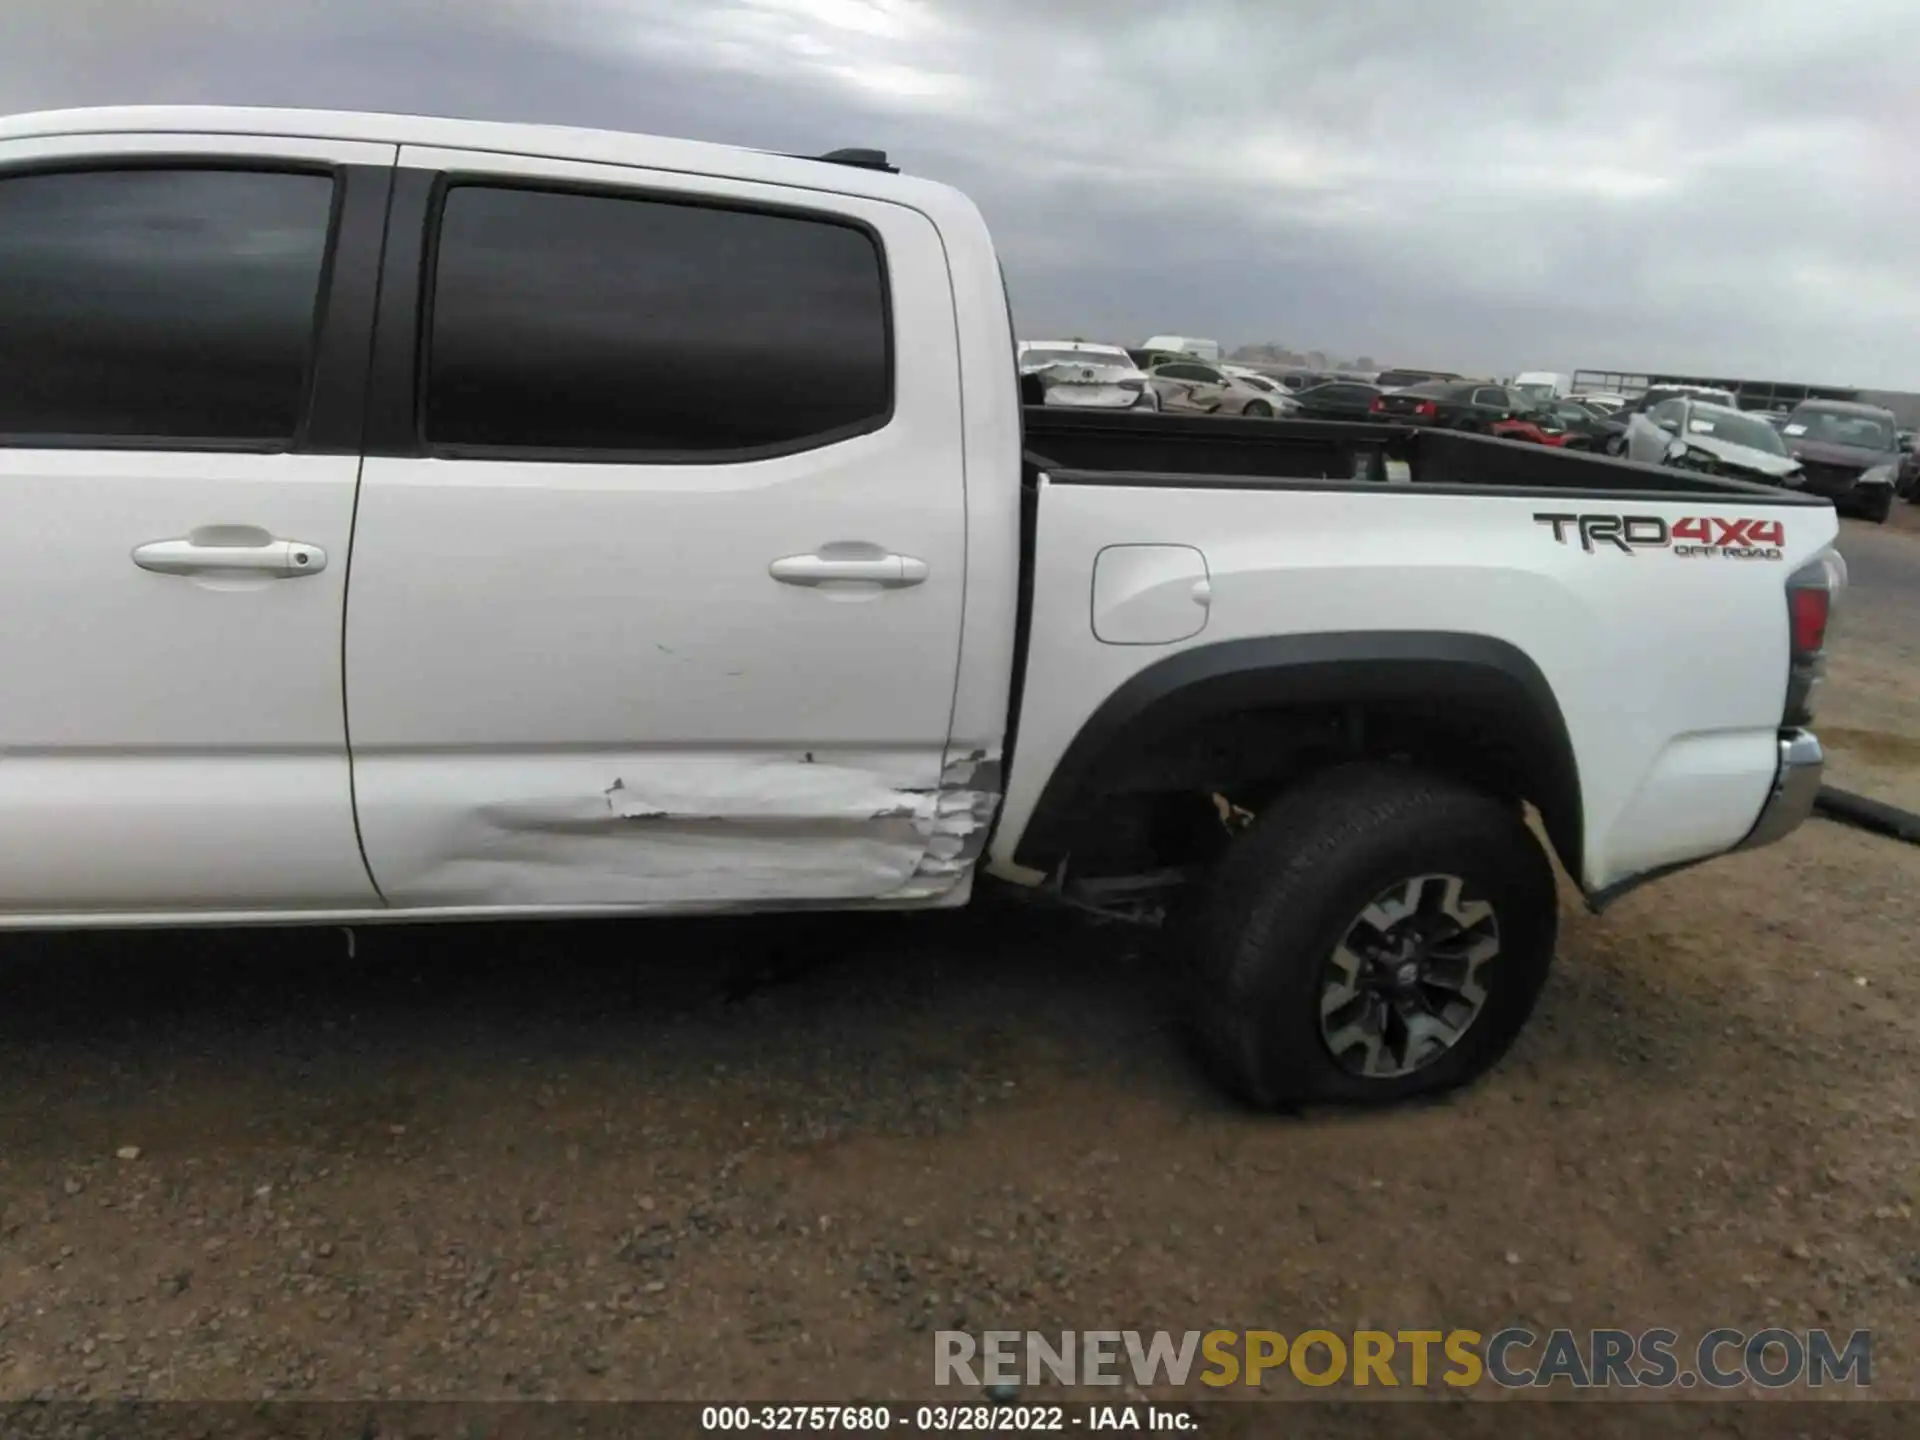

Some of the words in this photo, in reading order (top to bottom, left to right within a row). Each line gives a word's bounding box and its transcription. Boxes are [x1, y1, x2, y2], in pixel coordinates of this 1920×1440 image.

[1533, 512, 1672, 556] TRD
[1673, 545, 1716, 558] OFF
[1721, 546, 1783, 561] ROAD
